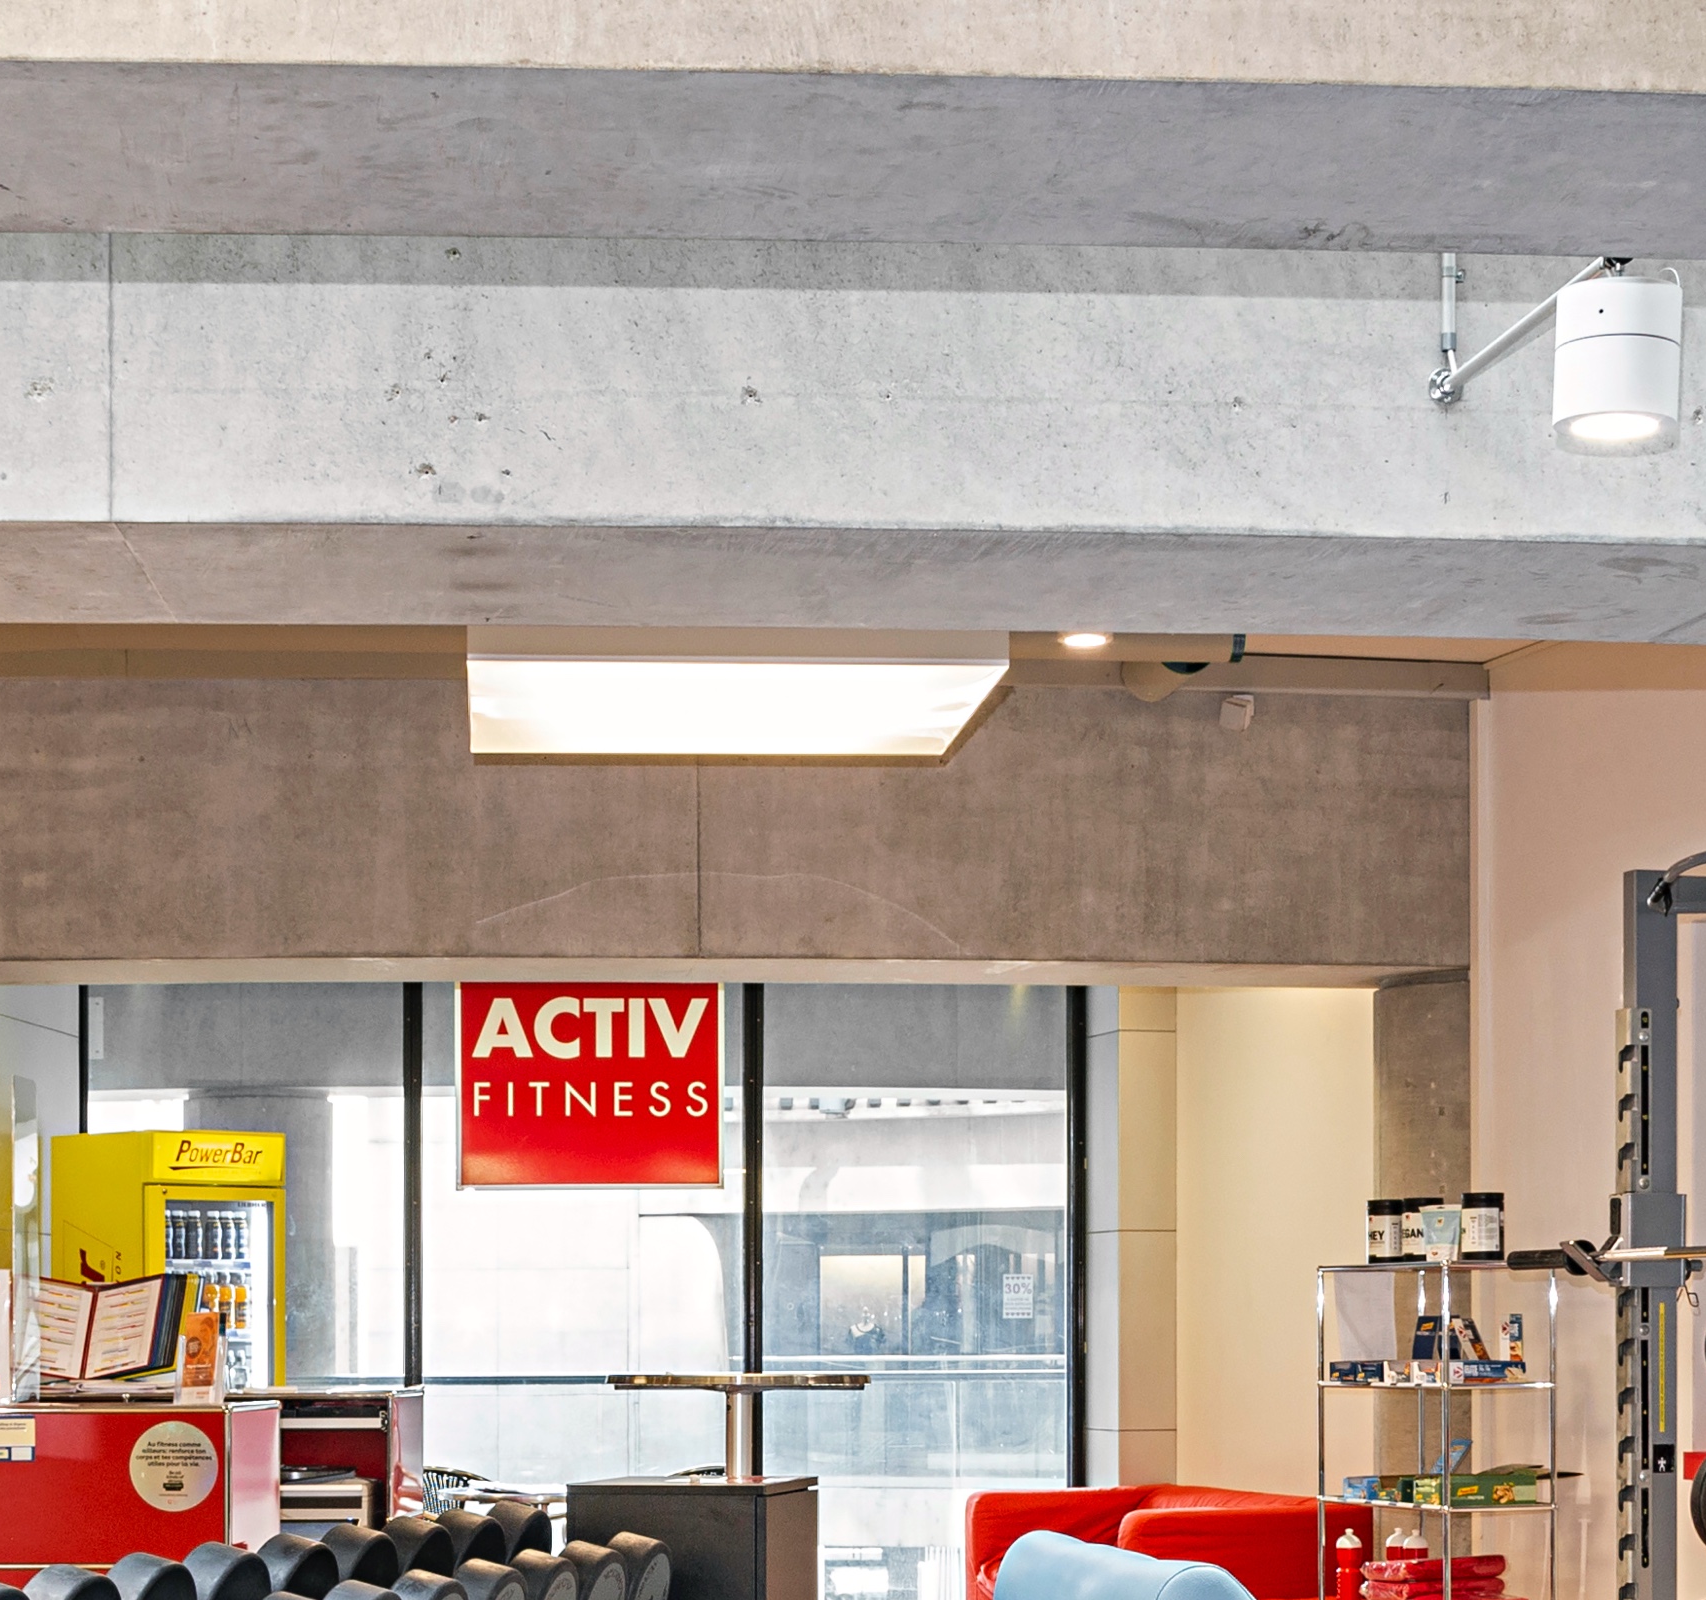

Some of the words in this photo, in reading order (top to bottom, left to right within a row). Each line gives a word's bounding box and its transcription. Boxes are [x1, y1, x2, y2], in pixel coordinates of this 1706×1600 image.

[471, 997, 709, 1059] ACTIV
[473, 1081, 708, 1118] FITNESS
[175, 1139, 263, 1164] PowerBar
[1005, 1283, 1032, 1295] 30%
